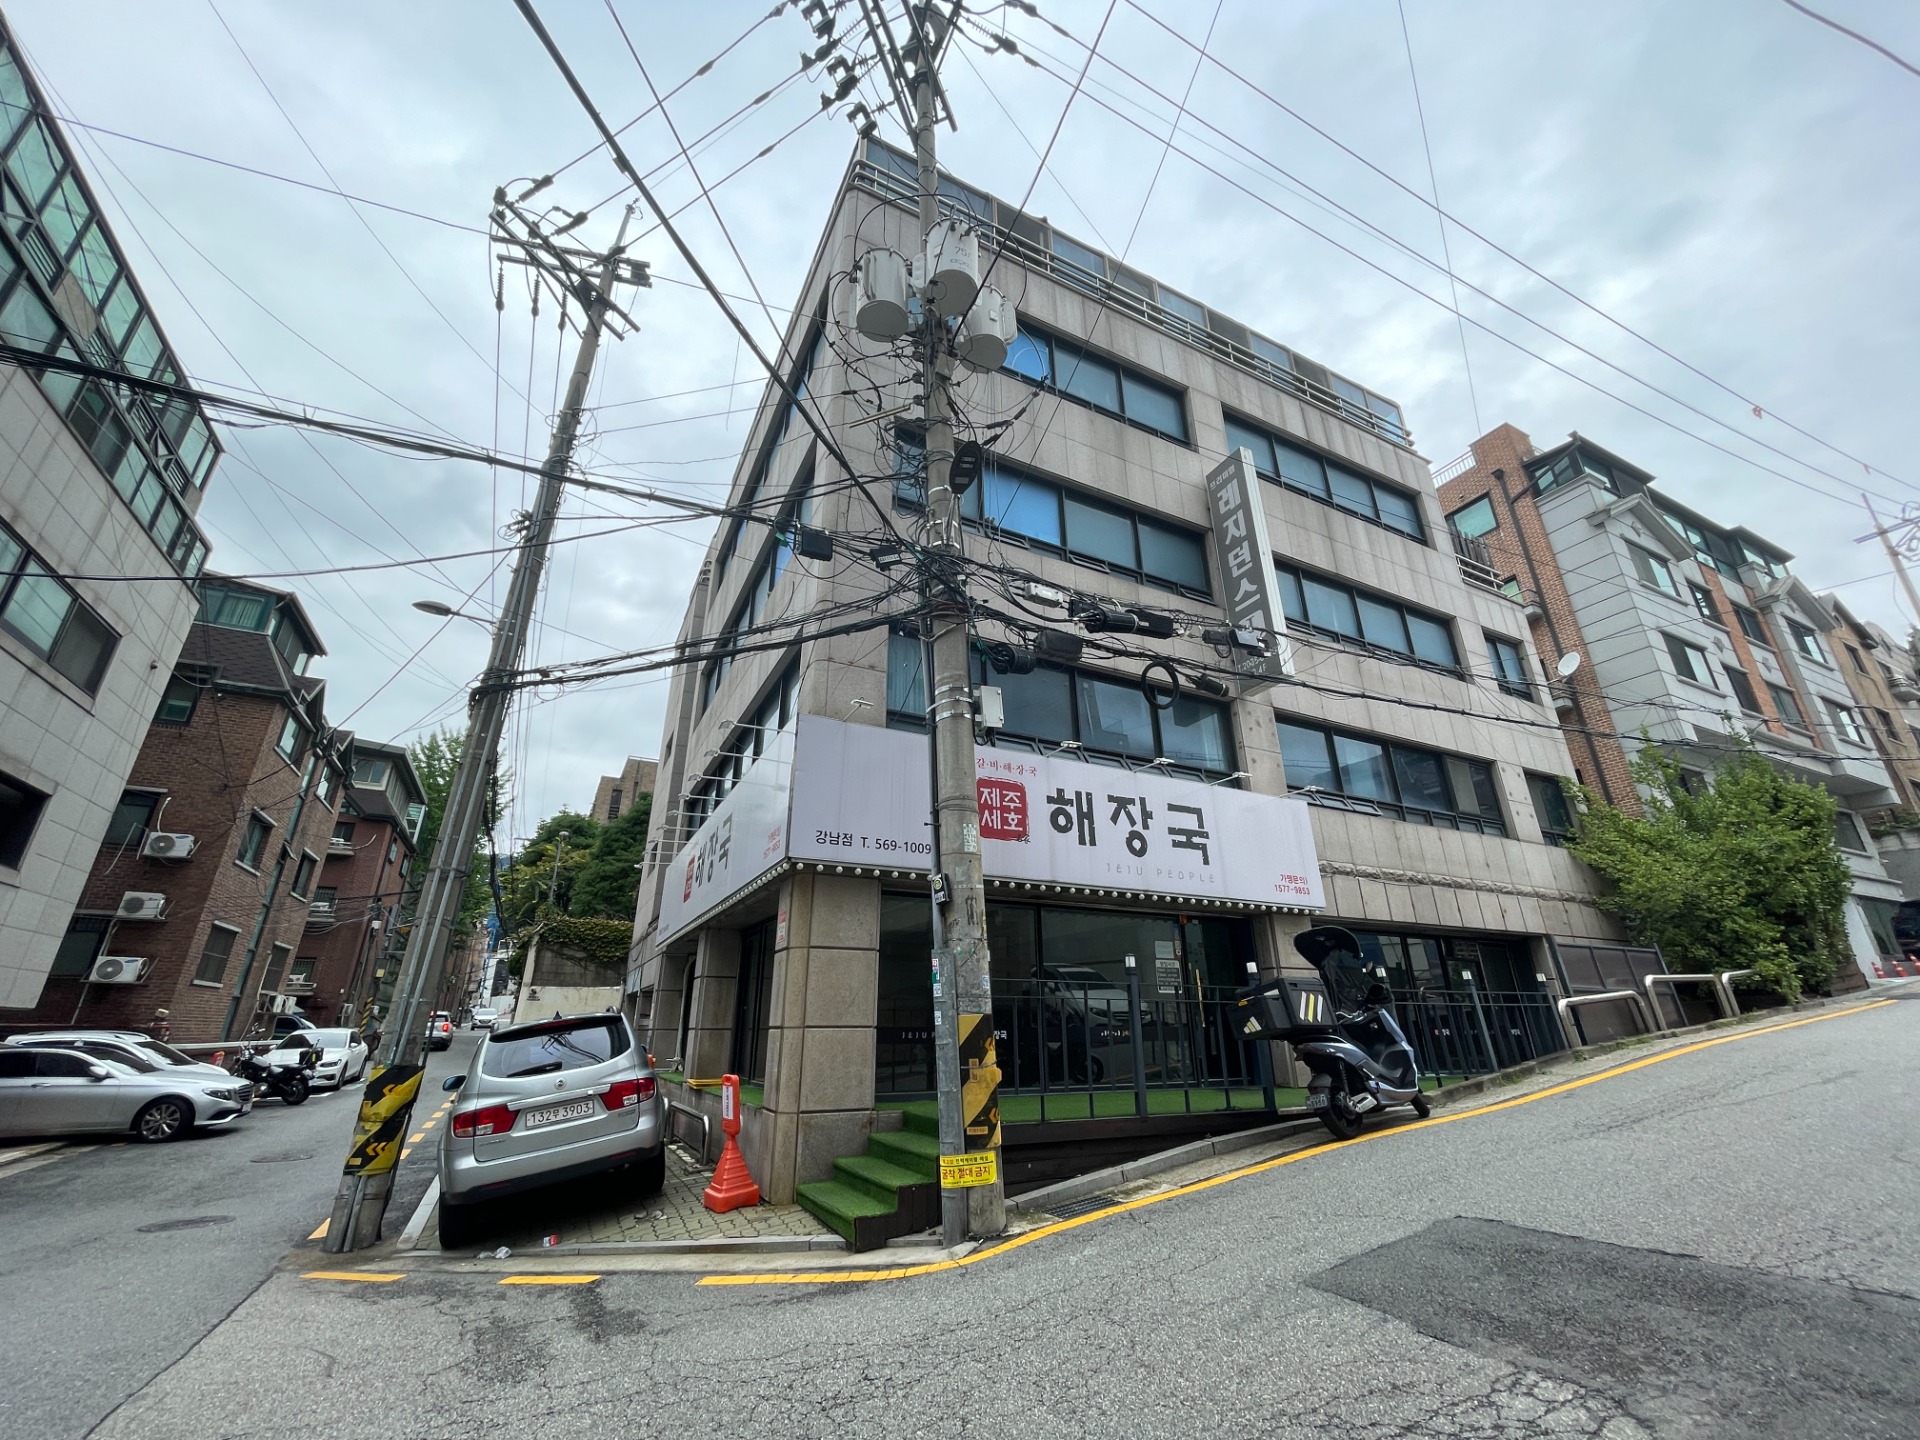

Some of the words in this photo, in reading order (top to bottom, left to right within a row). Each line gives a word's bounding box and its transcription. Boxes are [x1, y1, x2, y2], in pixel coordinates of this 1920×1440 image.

[1217, 478, 1260, 612] 레지던스
[980, 787, 1022, 810] 제주
[981, 809, 1024, 832] 세호
[1046, 788, 1211, 866] 해장국
[695, 812, 733, 888] 해장국
[815, 829, 853, 847] 강남점
[860, 836, 870, 849] T.
[875, 838, 932, 854] 569-1009
[1156, 868, 1215, 883] PEOPLE
[958, 1167, 973, 1179] 절대
[975, 1165, 990, 1177] 금지
